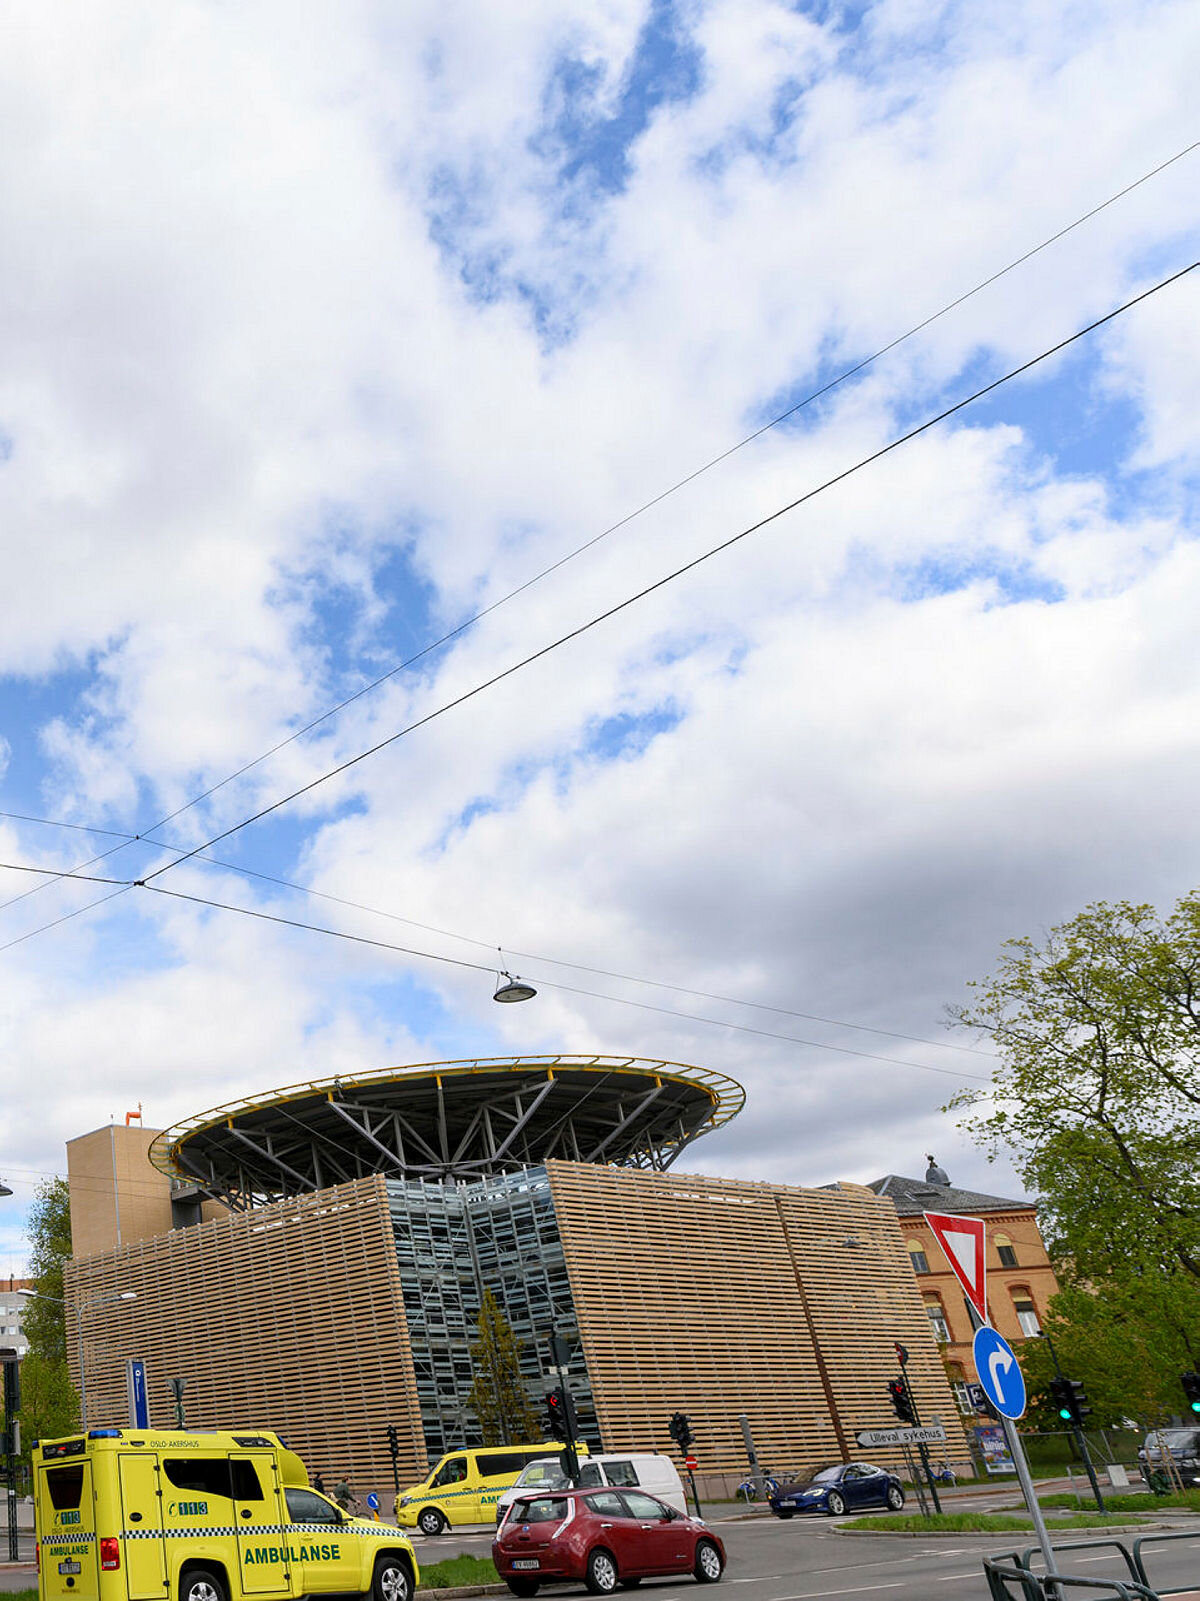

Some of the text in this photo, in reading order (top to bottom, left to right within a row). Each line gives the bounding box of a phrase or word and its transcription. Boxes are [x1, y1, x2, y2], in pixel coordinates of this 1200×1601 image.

[903, 1429, 941, 1441] sykehus
[179, 1502, 207, 1515] 113
[61, 1511, 81, 1524] 113
[50, 1545, 88, 1556] AMBULANSE
[244, 1544, 340, 1564] AMBULANSE
